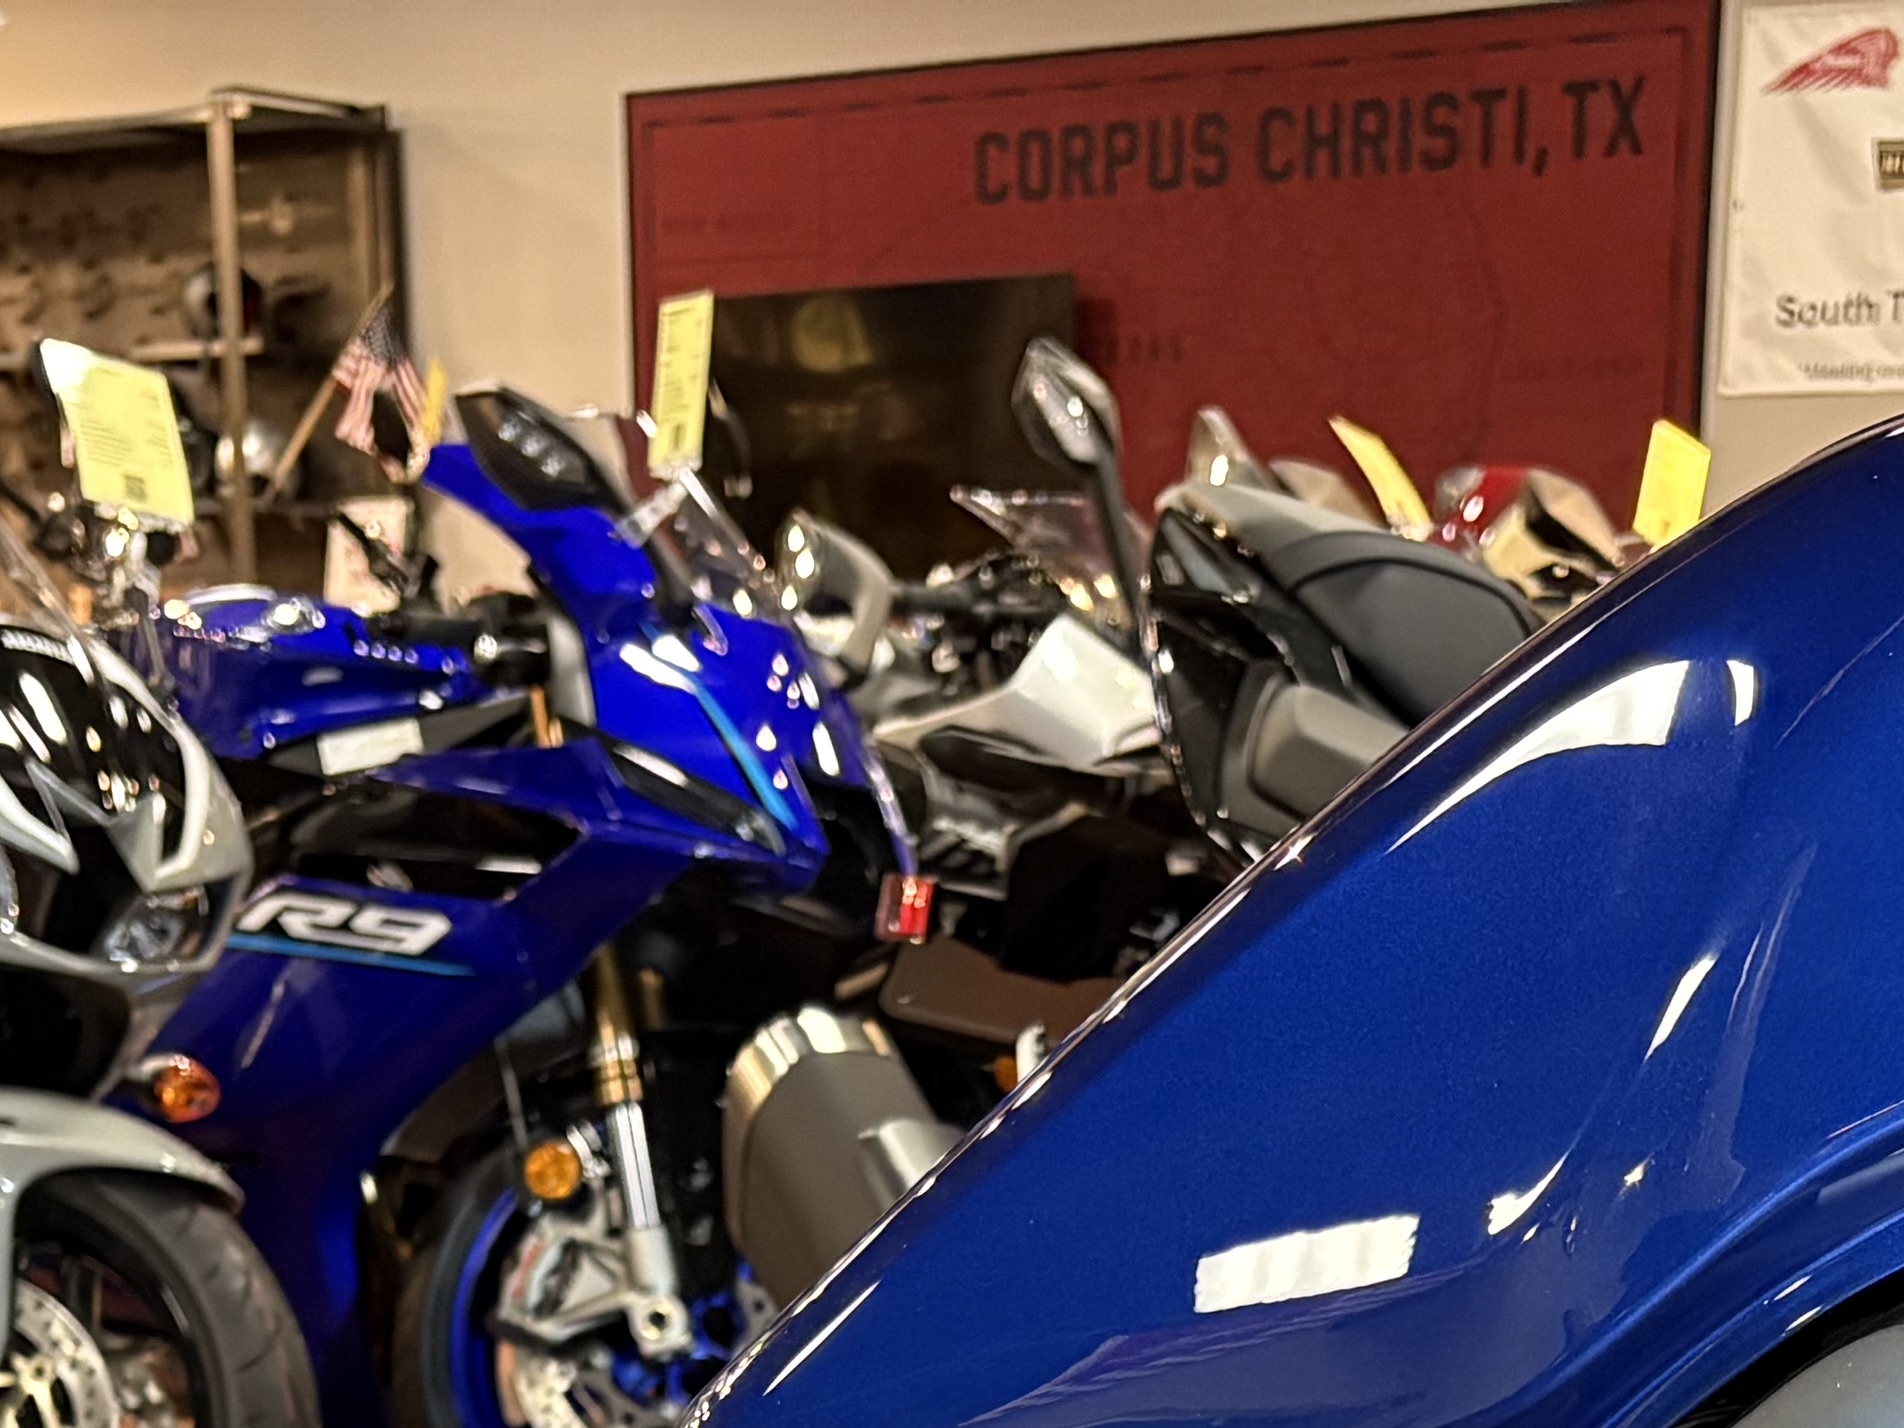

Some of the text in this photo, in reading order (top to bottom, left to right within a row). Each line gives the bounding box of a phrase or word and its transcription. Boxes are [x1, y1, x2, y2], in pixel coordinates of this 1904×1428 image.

[974, 75, 1646, 203] CORPUS CHRISTI, TX
[1775, 292, 1880, 327] South
[234, 891, 454, 956] R9
